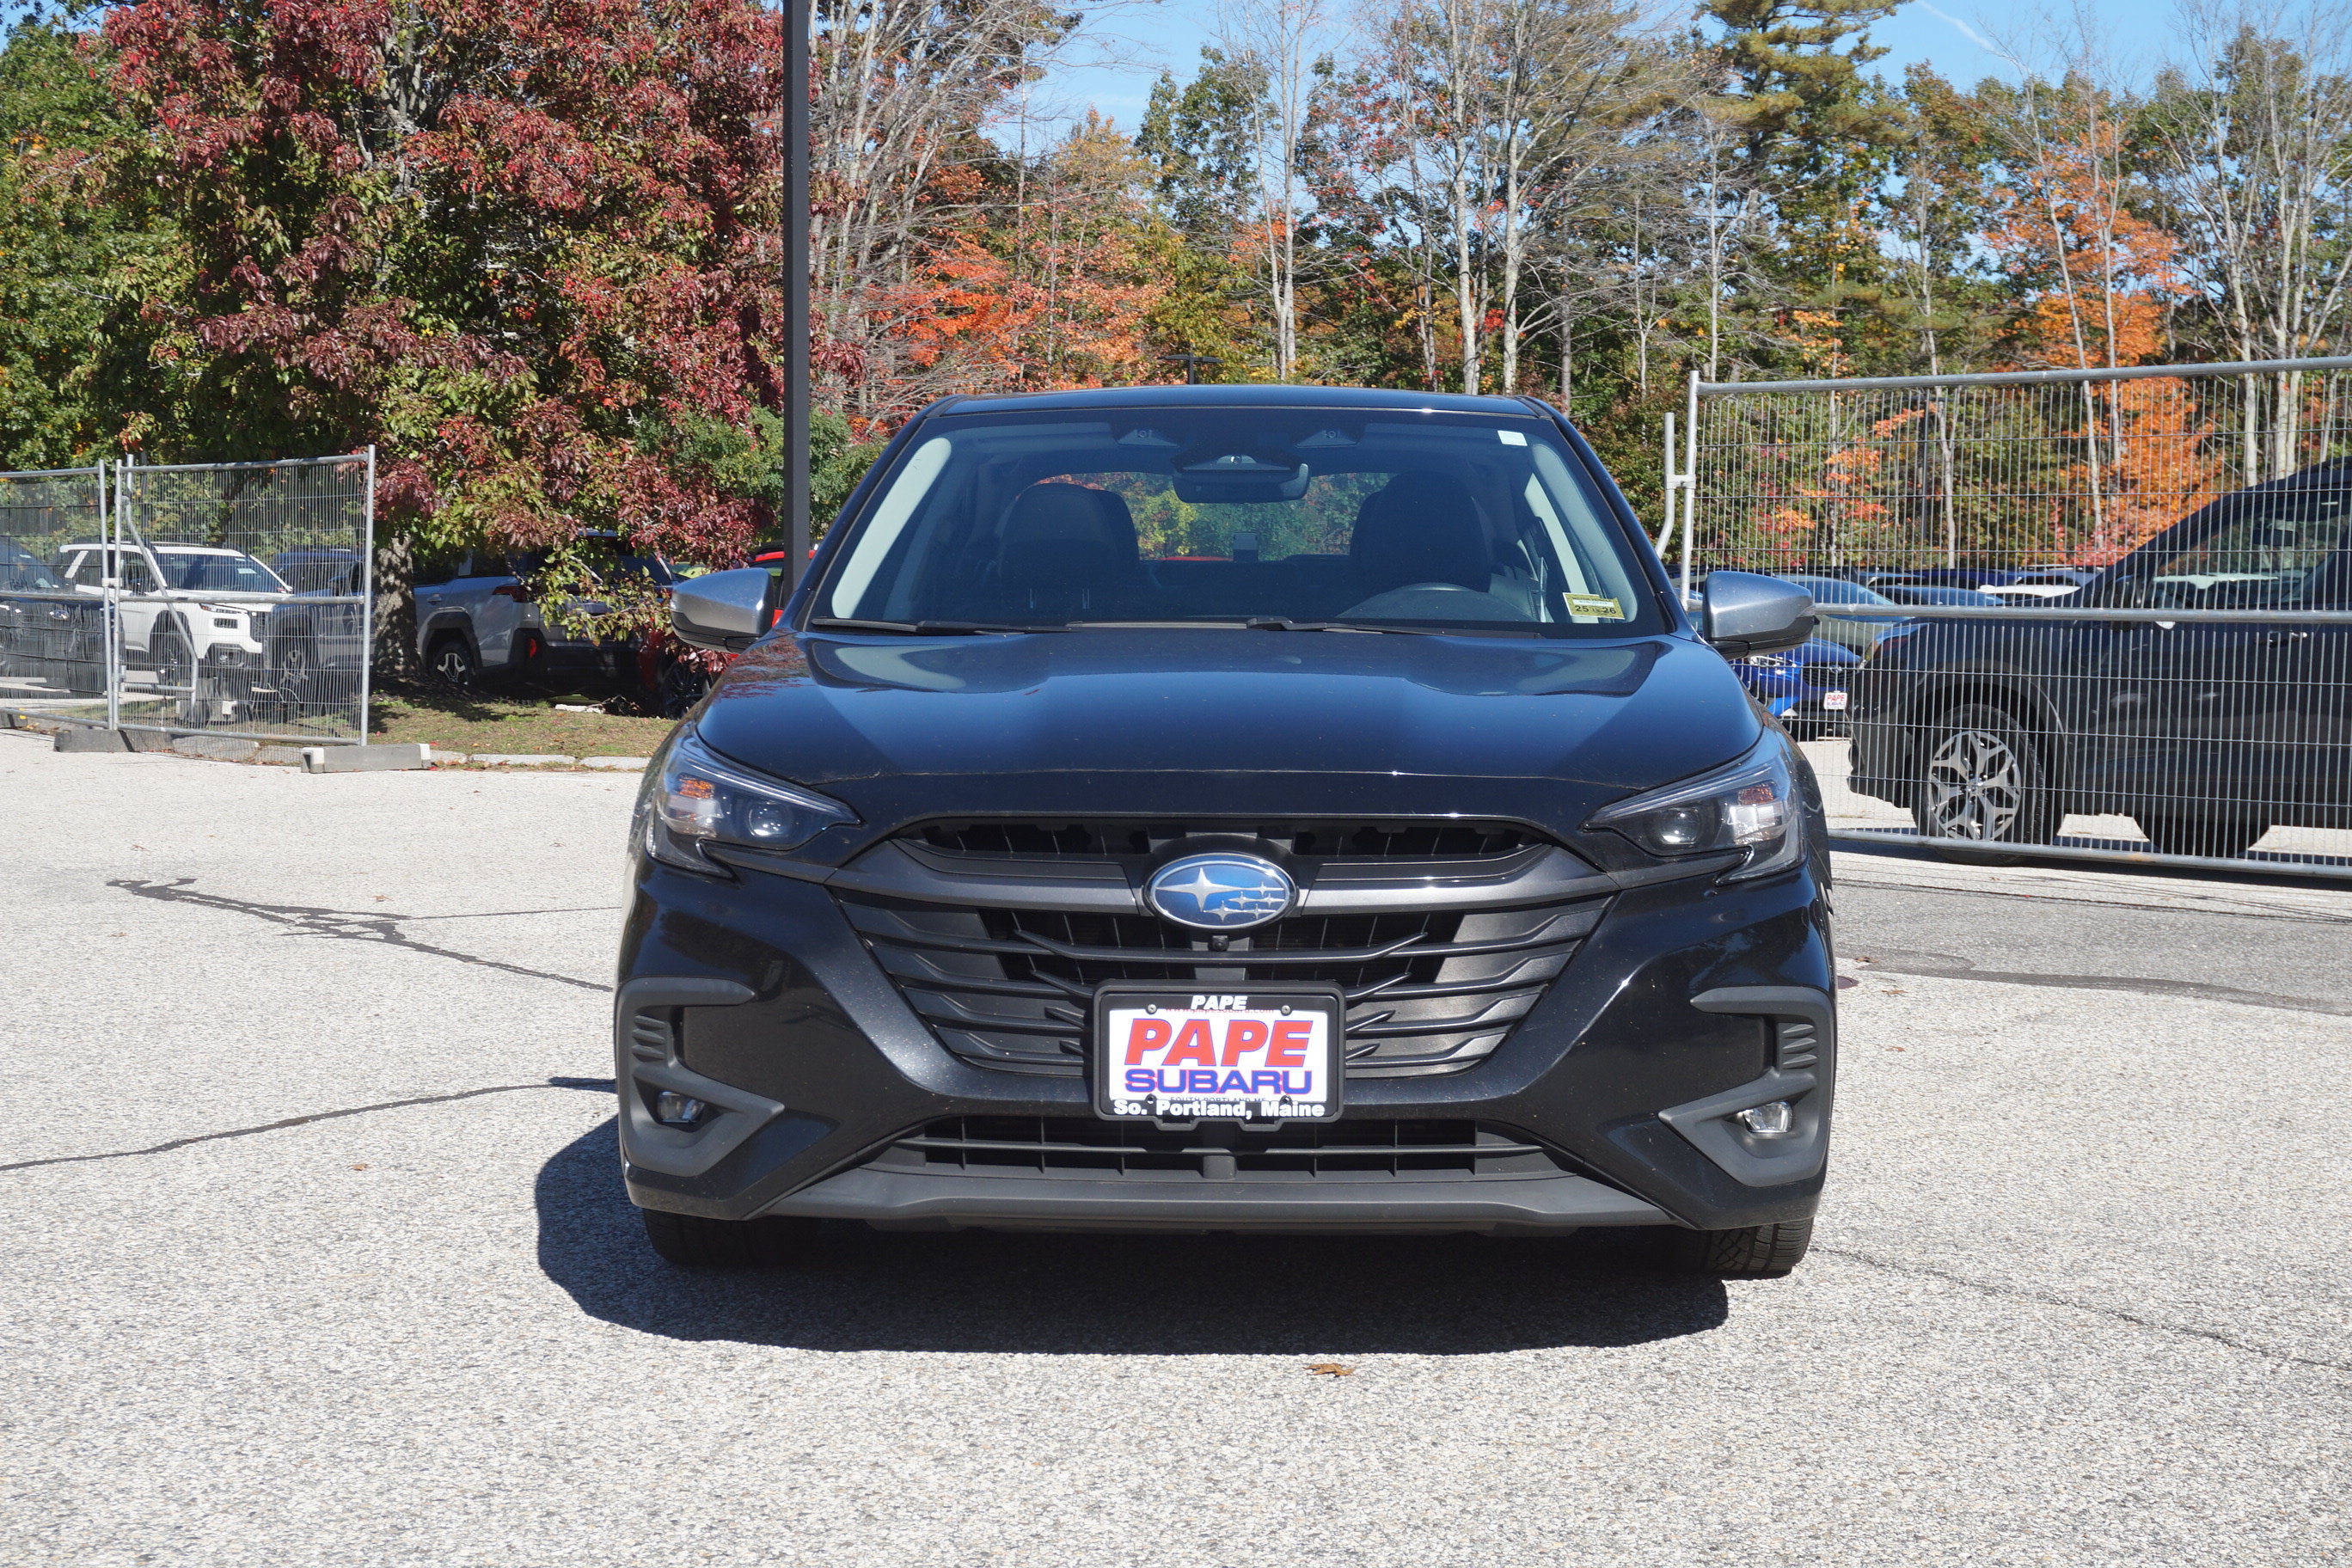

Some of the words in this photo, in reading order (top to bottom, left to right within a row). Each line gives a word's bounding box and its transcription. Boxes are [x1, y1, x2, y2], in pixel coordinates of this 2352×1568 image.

[1190, 995, 1248, 1010] PAPE
[1124, 1018, 1314, 1067] PAPE
[1124, 1069, 1312, 1094] SUBARU
[1113, 1099, 1148, 1116] So.
[1155, 1099, 1253, 1120] Portland,
[1261, 1100, 1325, 1118] Maine
